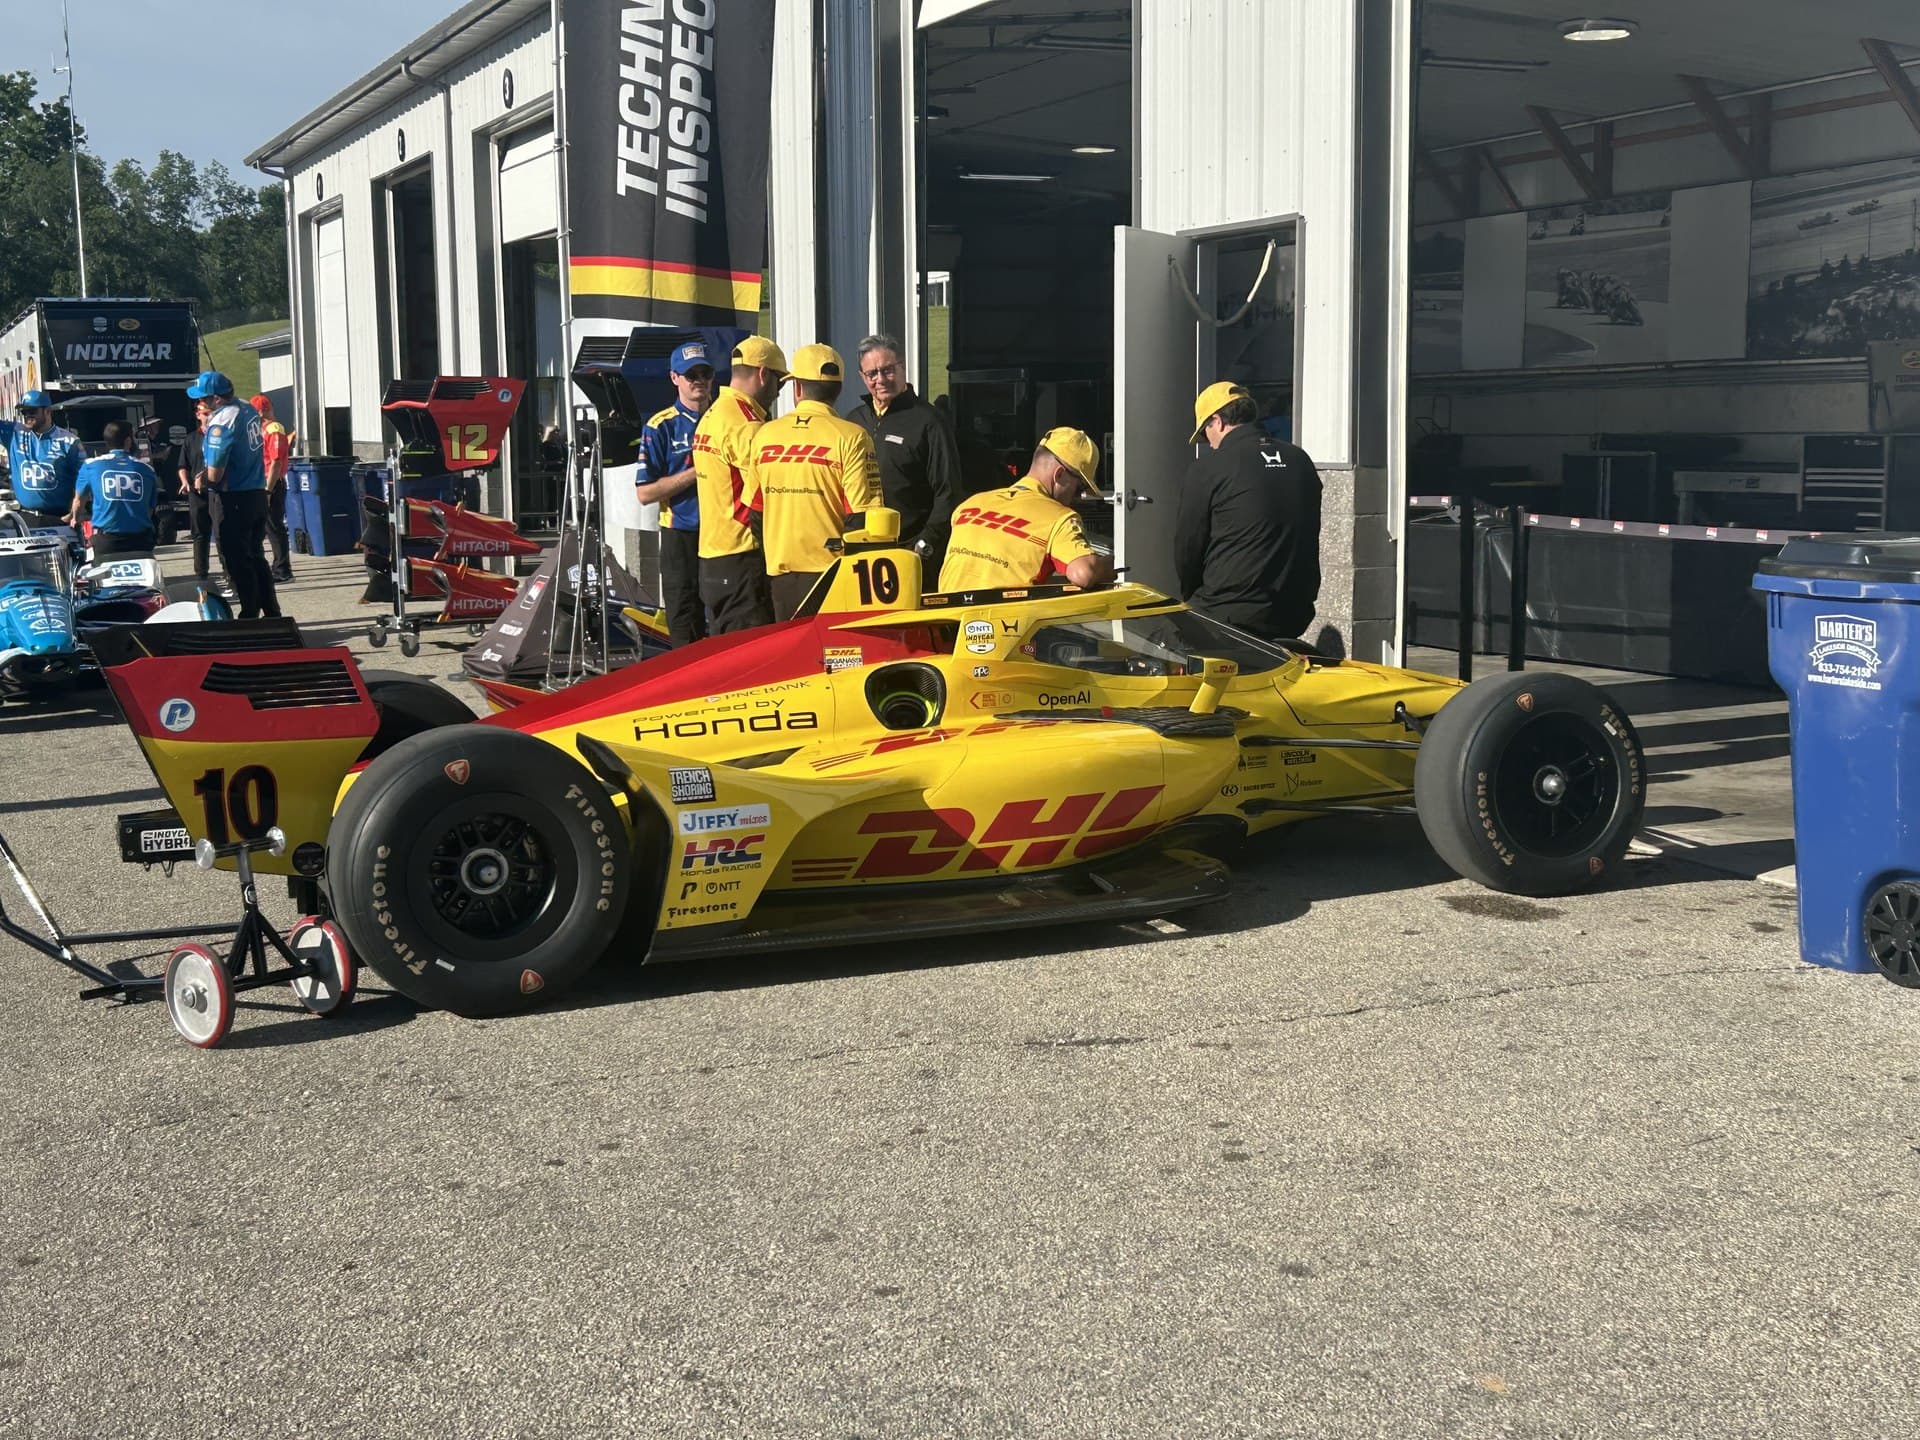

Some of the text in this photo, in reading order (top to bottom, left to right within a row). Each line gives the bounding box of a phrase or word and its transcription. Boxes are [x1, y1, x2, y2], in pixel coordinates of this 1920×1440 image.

[65, 343, 172, 361] INDYCAR
[447, 424, 489, 461] 12
[759, 445, 836, 468] DHL
[23, 464, 56, 487] PPG
[104, 474, 141, 497] PPG
[956, 508, 1032, 540] DHL
[452, 540, 510, 552] HITACHI
[112, 564, 141, 577] PPG
[852, 557, 900, 605] 10
[1819, 621, 1873, 641] HARTER'S
[764, 681, 811, 696] BANK
[755, 698, 785, 709] by
[1038, 691, 1091, 709] OpenAI
[635, 710, 819, 741] Honda
[670, 771, 711, 785] TRENCH
[672, 784, 712, 798] SHORING
[193, 764, 279, 847] 10
[852, 784, 1167, 879] DHL
[564, 783, 616, 912] Firestone
[681, 834, 766, 869] HRC
[680, 862, 762, 877] Honda RACING
[719, 881, 742, 892] NTT
[372, 844, 428, 977] Firestone
[667, 902, 737, 919] Firestone
